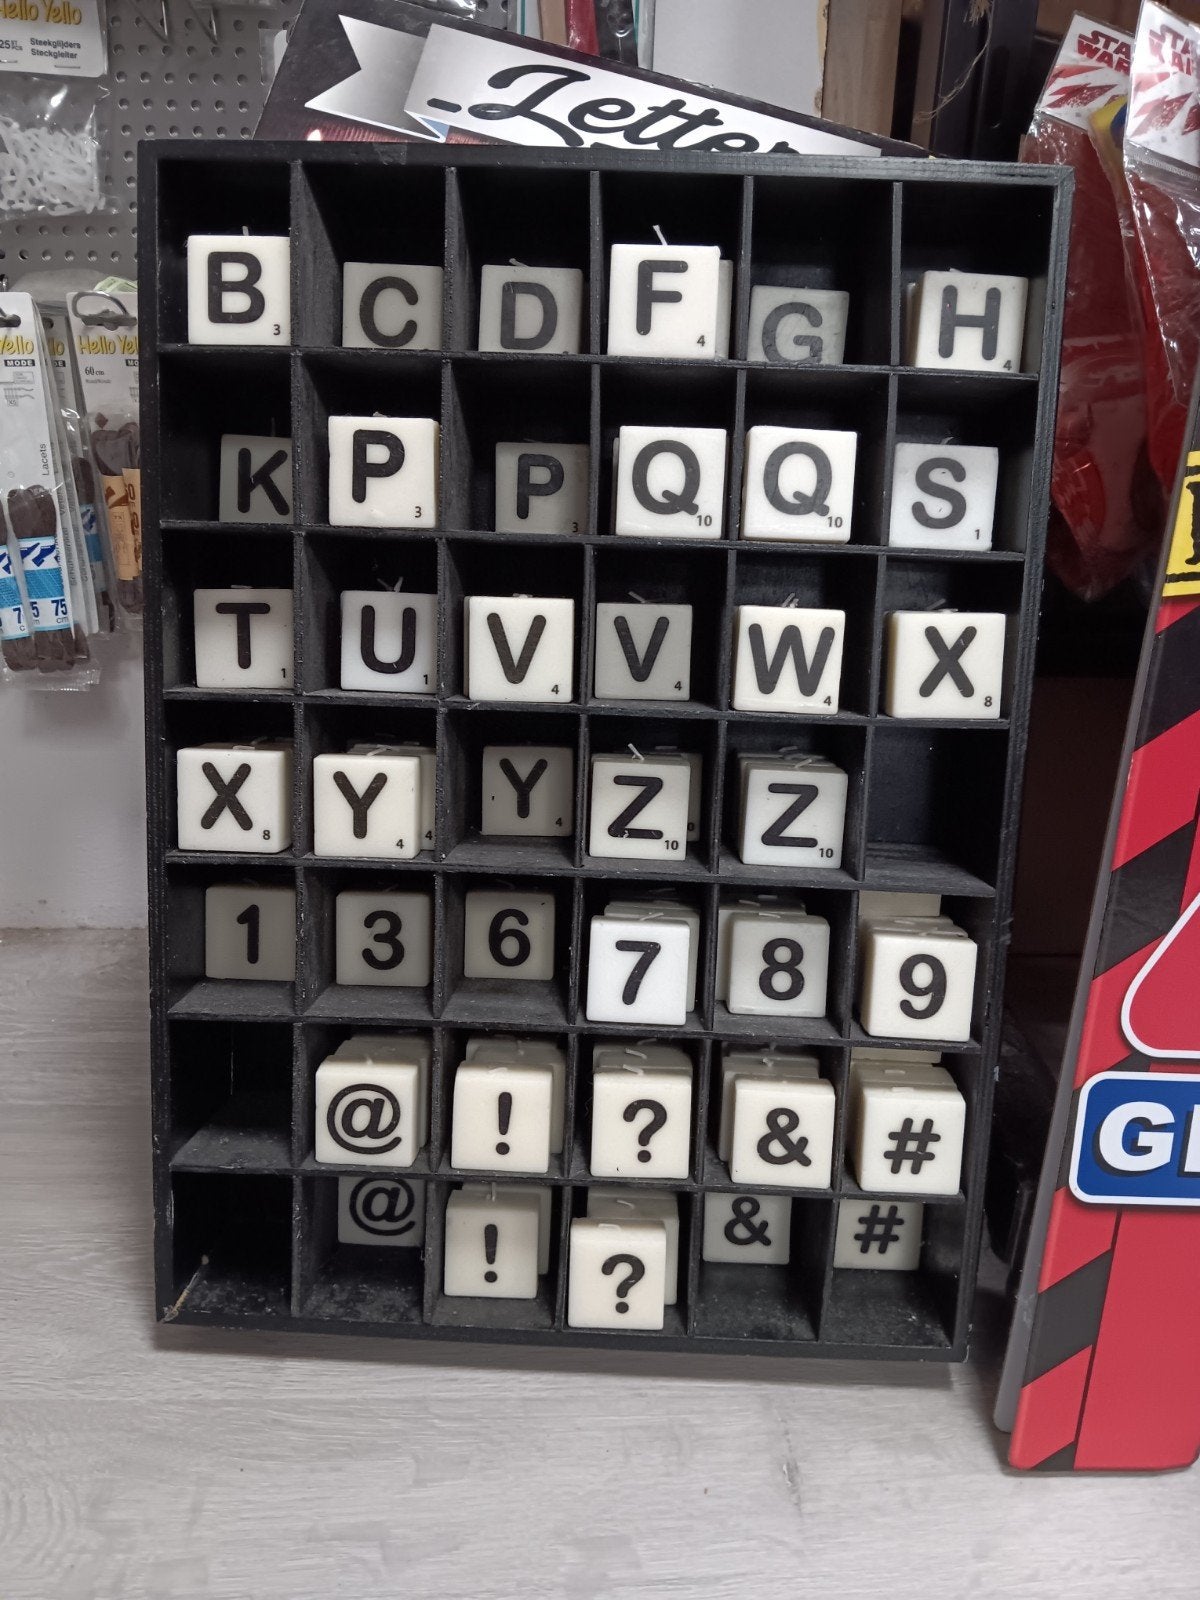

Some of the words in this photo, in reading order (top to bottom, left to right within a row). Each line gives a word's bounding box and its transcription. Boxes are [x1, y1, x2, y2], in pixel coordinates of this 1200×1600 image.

[43, 0, 82, 25] Yello
[1077, 39, 1131, 76] WAR
[1078, 30, 1132, 60] STA
[208, 251, 265, 324] B
[359, 276, 418, 348] C
[500, 281, 558, 350] D
[636, 260, 688, 336] F
[79, 335, 116, 355] Hello
[118, 335, 138, 355] Yel
[273, 324, 281, 336] 3
[696, 335, 706, 347] 4
[762, 302, 823, 364] G
[938, 285, 1001, 361] H
[1003, 359, 1012, 372] 4
[237, 448, 290, 516] K
[352, 429, 405, 503] P
[517, 453, 565, 520] P
[632, 440, 700, 516] Q
[763, 441, 832, 516] Q
[911, 457, 967, 529] S
[415, 506, 422, 518] 3
[572, 522, 578, 533] 3
[696, 515, 713, 527] 10
[827, 516, 843, 528] 10
[974, 529, 981, 540] 1
[51, 599, 67, 616] 75
[215, 602, 270, 669] T
[361, 605, 416, 674] U
[487, 612, 546, 684] V
[613, 615, 669, 682] V
[748, 623, 835, 697] W
[919, 625, 977, 697] X
[281, 668, 286, 678] 1
[423, 675, 428, 685] 1
[551, 684, 560, 695] 4
[674, 681, 682, 691] 4
[823, 696, 832, 707] 4
[984, 695, 992, 707] 8
[201, 761, 253, 831] X
[333, 771, 387, 839] Y
[499, 758, 548, 818] Y
[607, 775, 663, 840] Z
[761, 783, 818, 848] Z
[262, 830, 271, 840] 8
[396, 839, 404, 850] 4
[425, 830, 432, 840] 4
[555, 817, 562, 827] 4
[664, 840, 679, 851] 10
[819, 848, 834, 858] 10
[236, 904, 260, 965] 1
[361, 910, 405, 970] 3
[488, 908, 531, 967] 6
[615, 940, 661, 1006] 7
[759, 938, 805, 1001] 8
[899, 954, 947, 1020] 9
[326, 1083, 402, 1155] @
[495, 1091, 513, 1156] !
[622, 1099, 667, 1164] ?
[757, 1107, 812, 1167] &
[883, 1117, 941, 1175] #
[349, 1177, 415, 1236] @
[724, 1196, 772, 1247] &
[853, 1205, 905, 1255] #
[483, 1223, 498, 1283] !
[601, 1253, 645, 1314] ?
